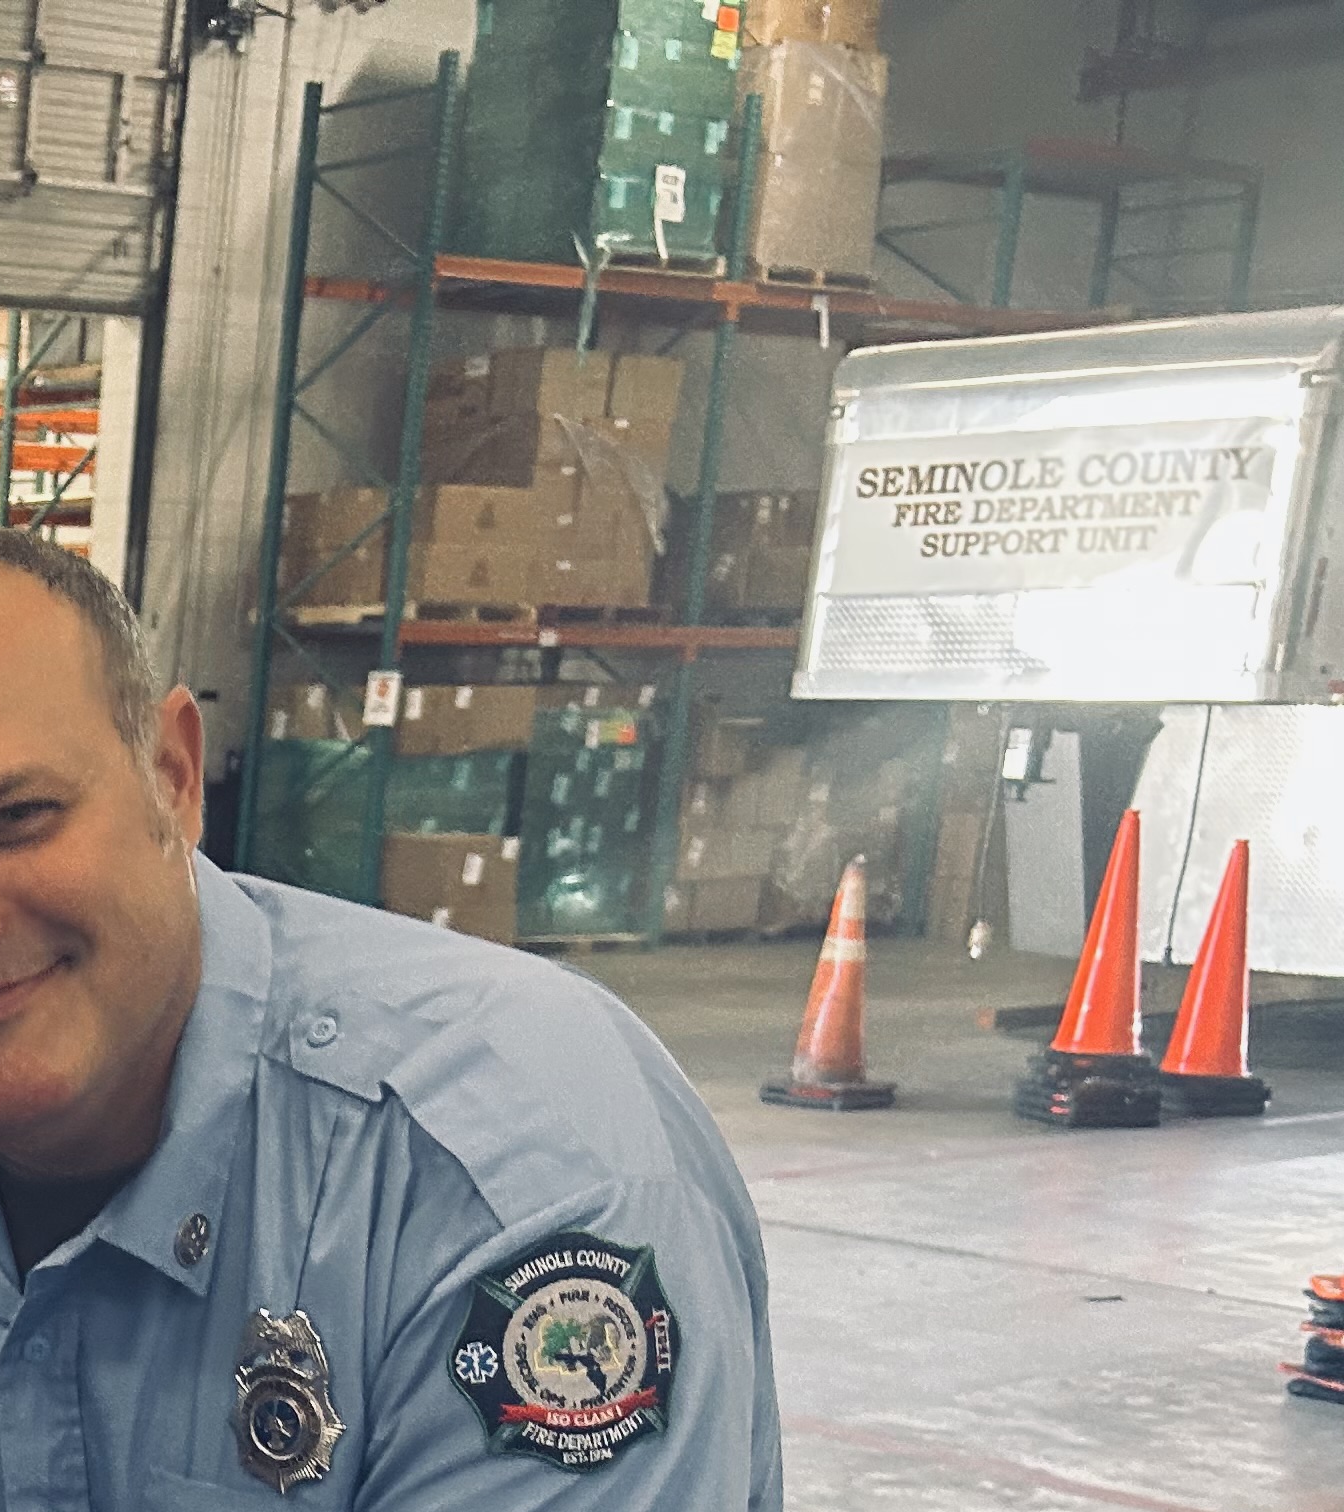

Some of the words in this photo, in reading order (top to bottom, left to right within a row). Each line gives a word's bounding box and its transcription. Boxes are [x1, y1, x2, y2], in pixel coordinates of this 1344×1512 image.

[856, 457, 1064, 499] SEMINOLE
[1078, 447, 1262, 487] COUNTY
[891, 501, 962, 528] FIRE
[971, 490, 1201, 524] DEPARTMENT
[920, 528, 1068, 557] SUPPORT
[1077, 525, 1157, 554] UNIT
[505, 1250, 574, 1292] SEMINOLE
[576, 1250, 631, 1278] COUNTY
[522, 1421, 558, 1447] FIRE
[558, 1409, 643, 1450] DEPARTMENT
[546, 1411, 571, 1427] ISO
[573, 1406, 614, 1427] CLASS
